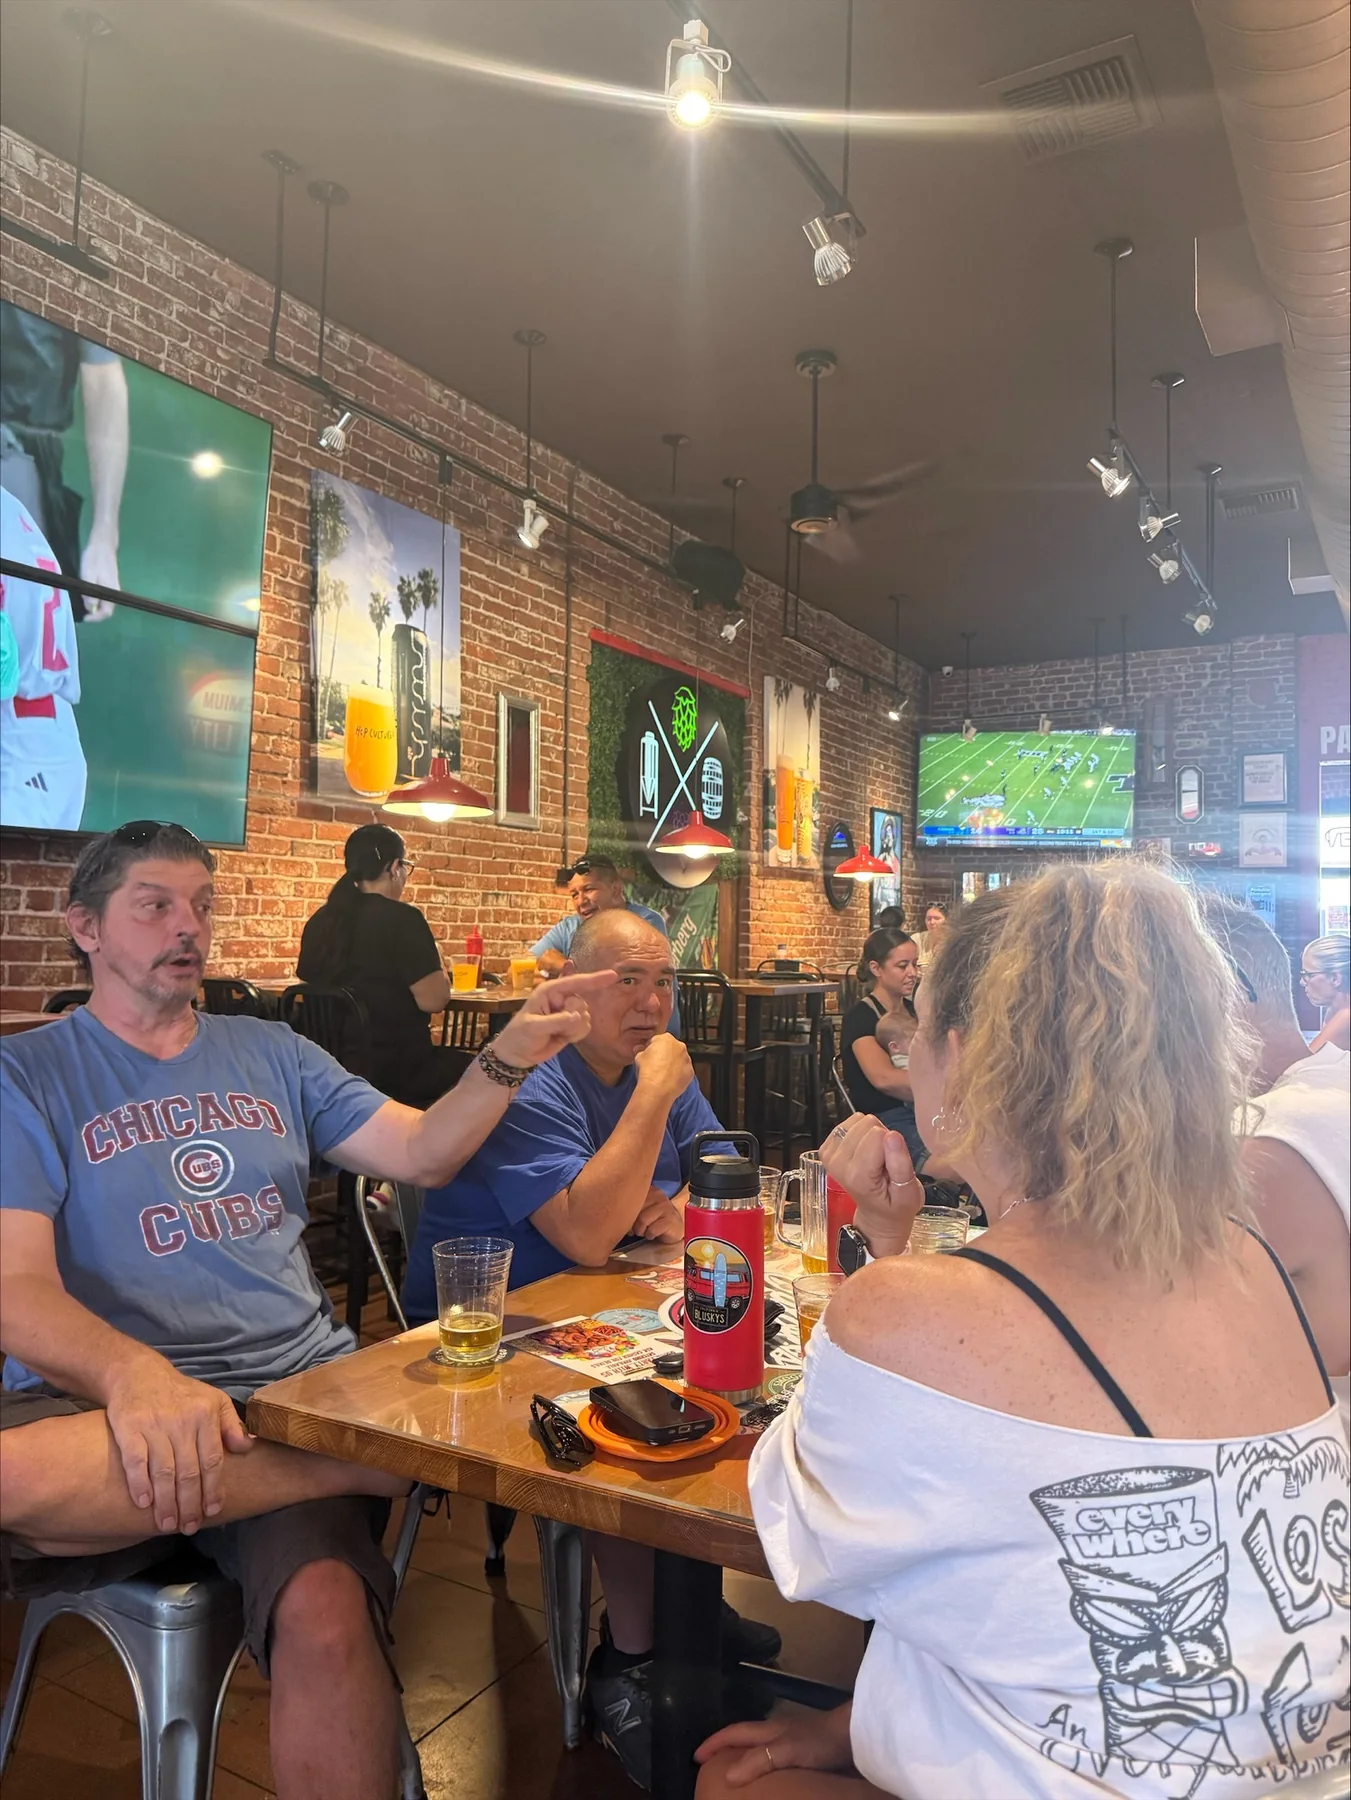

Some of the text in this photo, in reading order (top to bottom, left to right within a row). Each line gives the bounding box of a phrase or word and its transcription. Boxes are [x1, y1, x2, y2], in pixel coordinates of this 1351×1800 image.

[139, 1185, 285, 1257] CUBS
[694, 1308, 725, 1324] BLUSKYS
[1076, 1496, 1196, 1533] every
[1072, 1520, 1211, 1558] where
